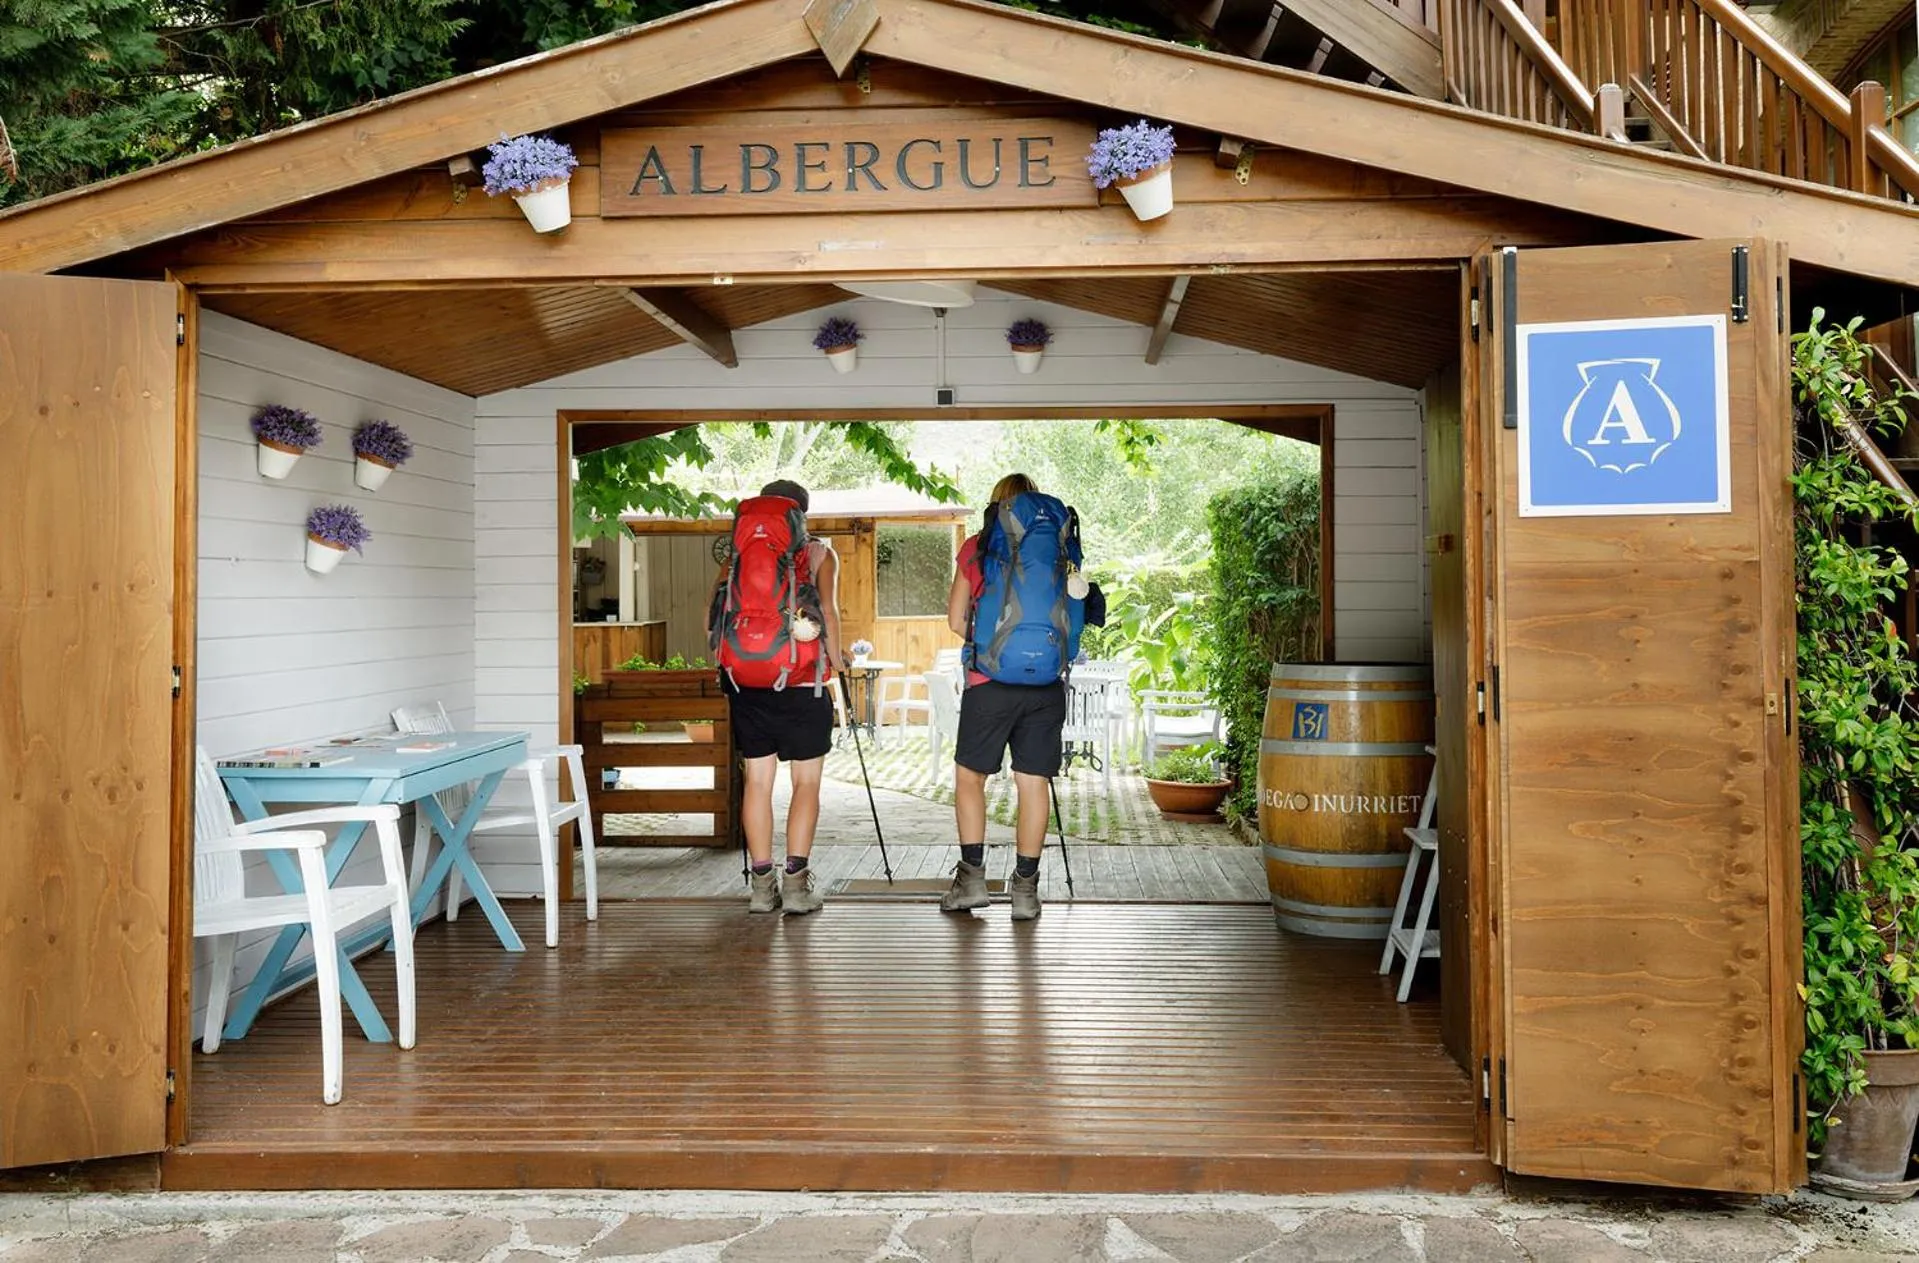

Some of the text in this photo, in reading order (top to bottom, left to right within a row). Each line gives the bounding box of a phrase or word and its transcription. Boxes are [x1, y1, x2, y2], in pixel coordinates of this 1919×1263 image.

[629, 136, 1057, 196] ALBERGUE
[1587, 379, 1657, 445] A
[1313, 794, 1421, 814] INURRIET
